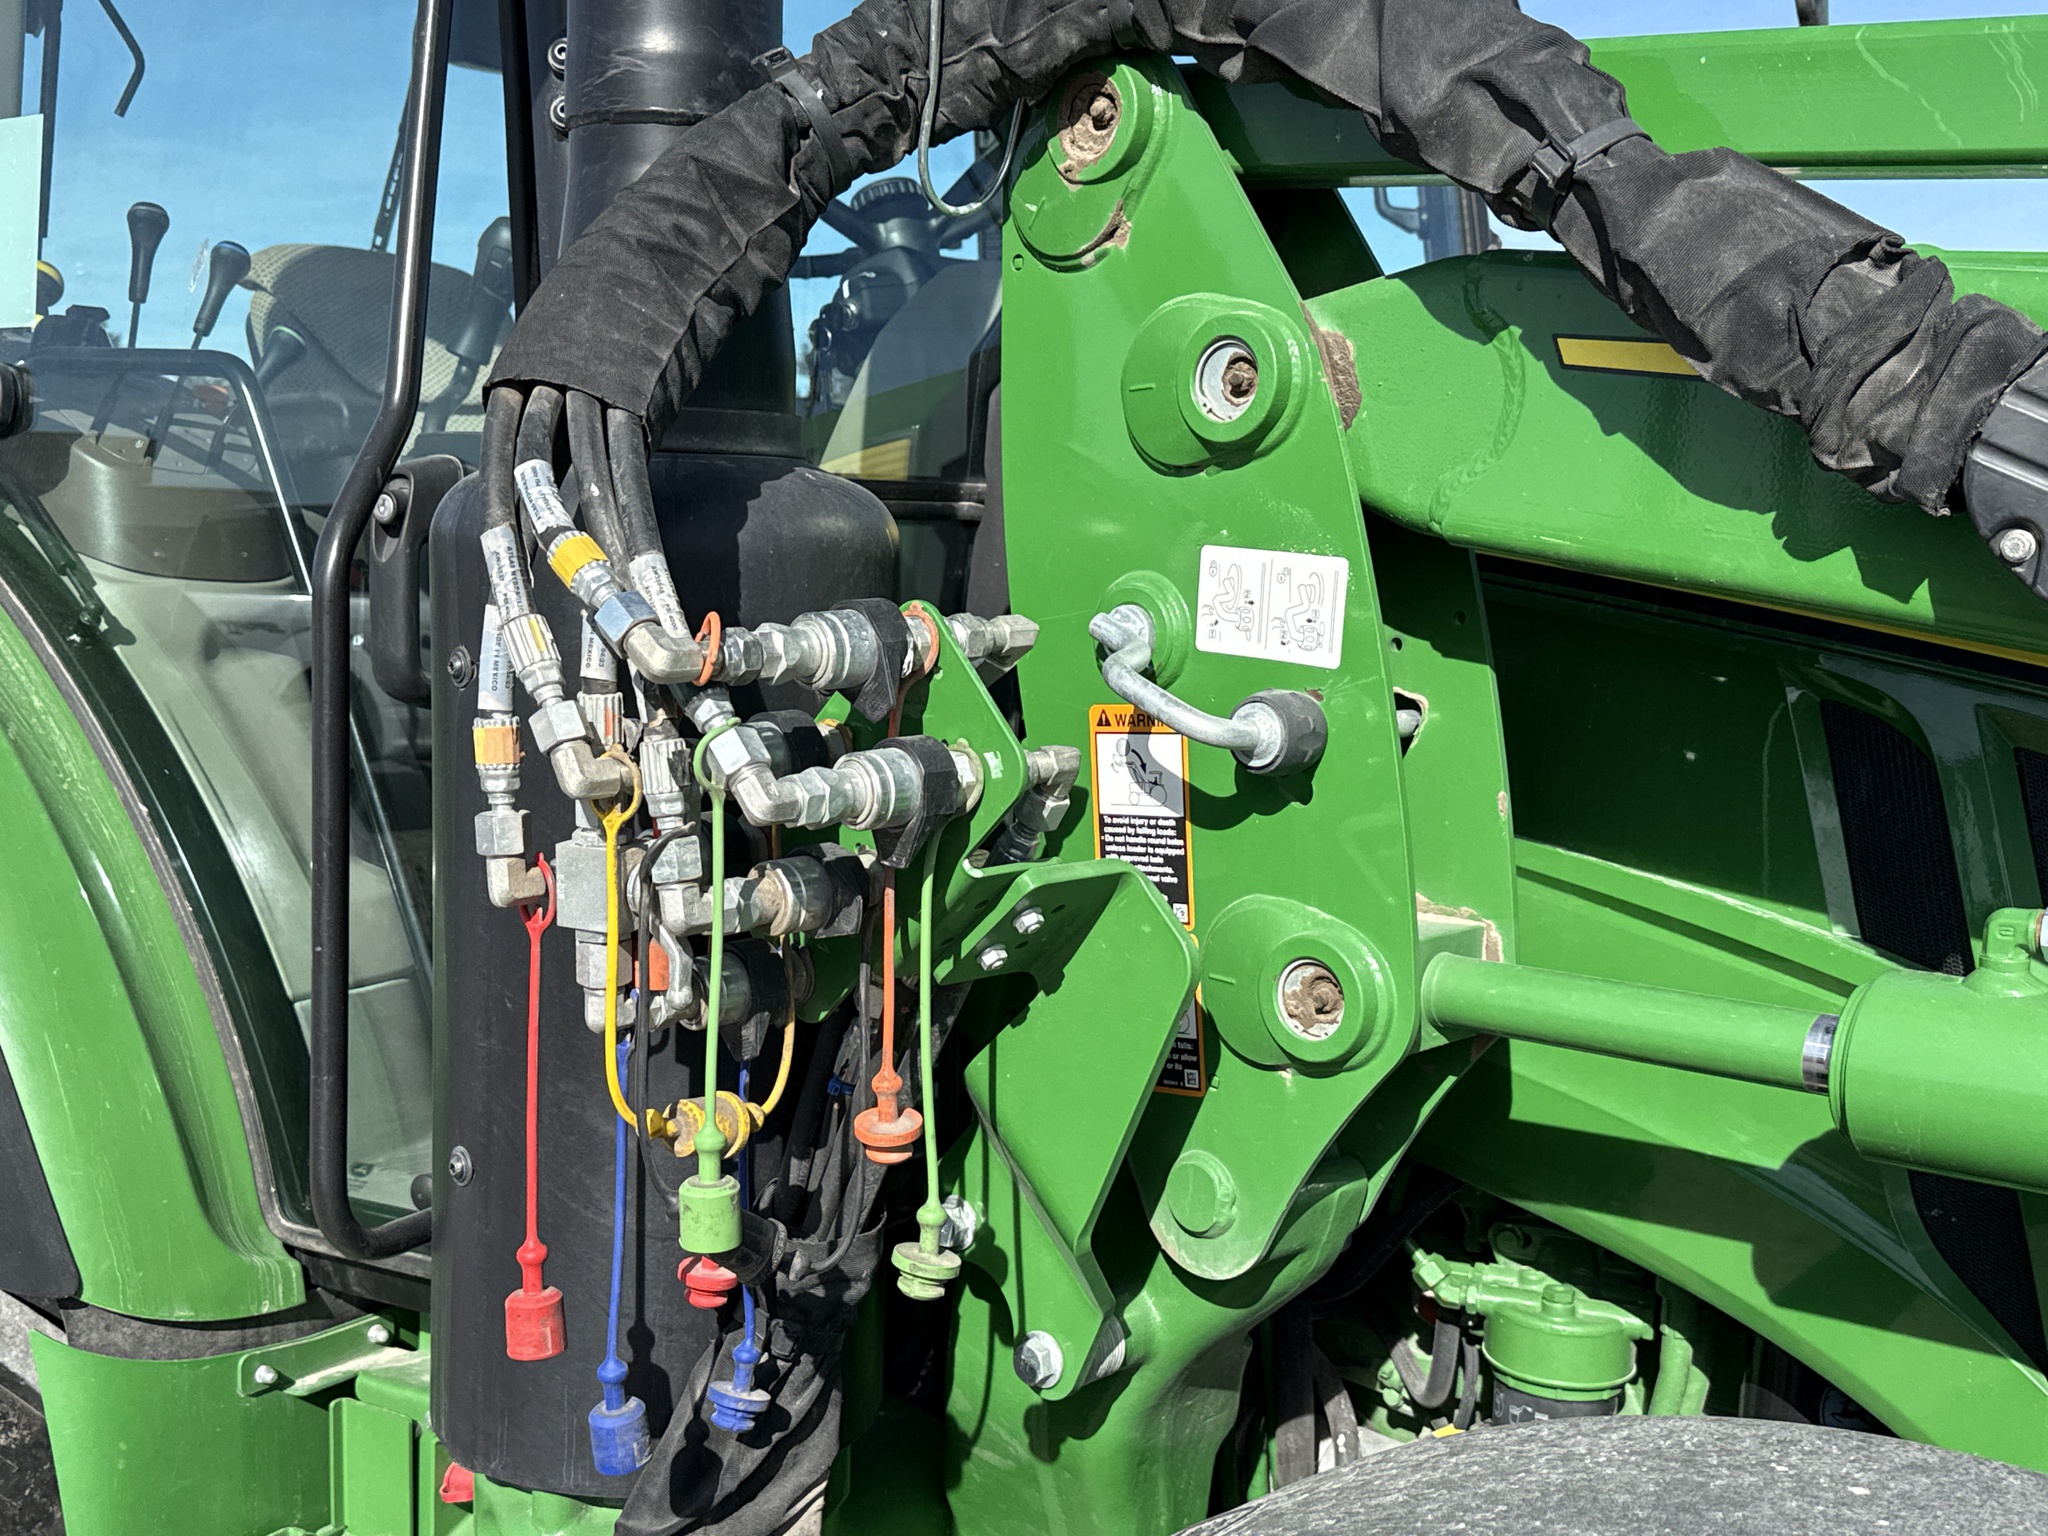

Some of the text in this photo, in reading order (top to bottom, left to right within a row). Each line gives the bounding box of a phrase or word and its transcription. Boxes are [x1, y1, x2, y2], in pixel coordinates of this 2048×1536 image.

[506, 545, 516, 568] ATLAS
[585, 637, 594, 668] MEXICO
[1115, 713, 1163, 727] WARNI
[1130, 817, 1148, 826] injury
[1127, 826, 1135, 835] by
[1136, 826, 1156, 836] falling
[1105, 834, 1114, 842] Do
[1126, 835, 1146, 843] handle
[1105, 844, 1125, 852] unless
[1127, 845, 1147, 853] loader
[1155, 847, 1184, 856] equipped
[1120, 854, 1149, 863] approved
[1161, 875, 1178, 883] valve
[1180, 1053, 1197, 1062] allow
[1174, 1062, 1183, 1070] its
